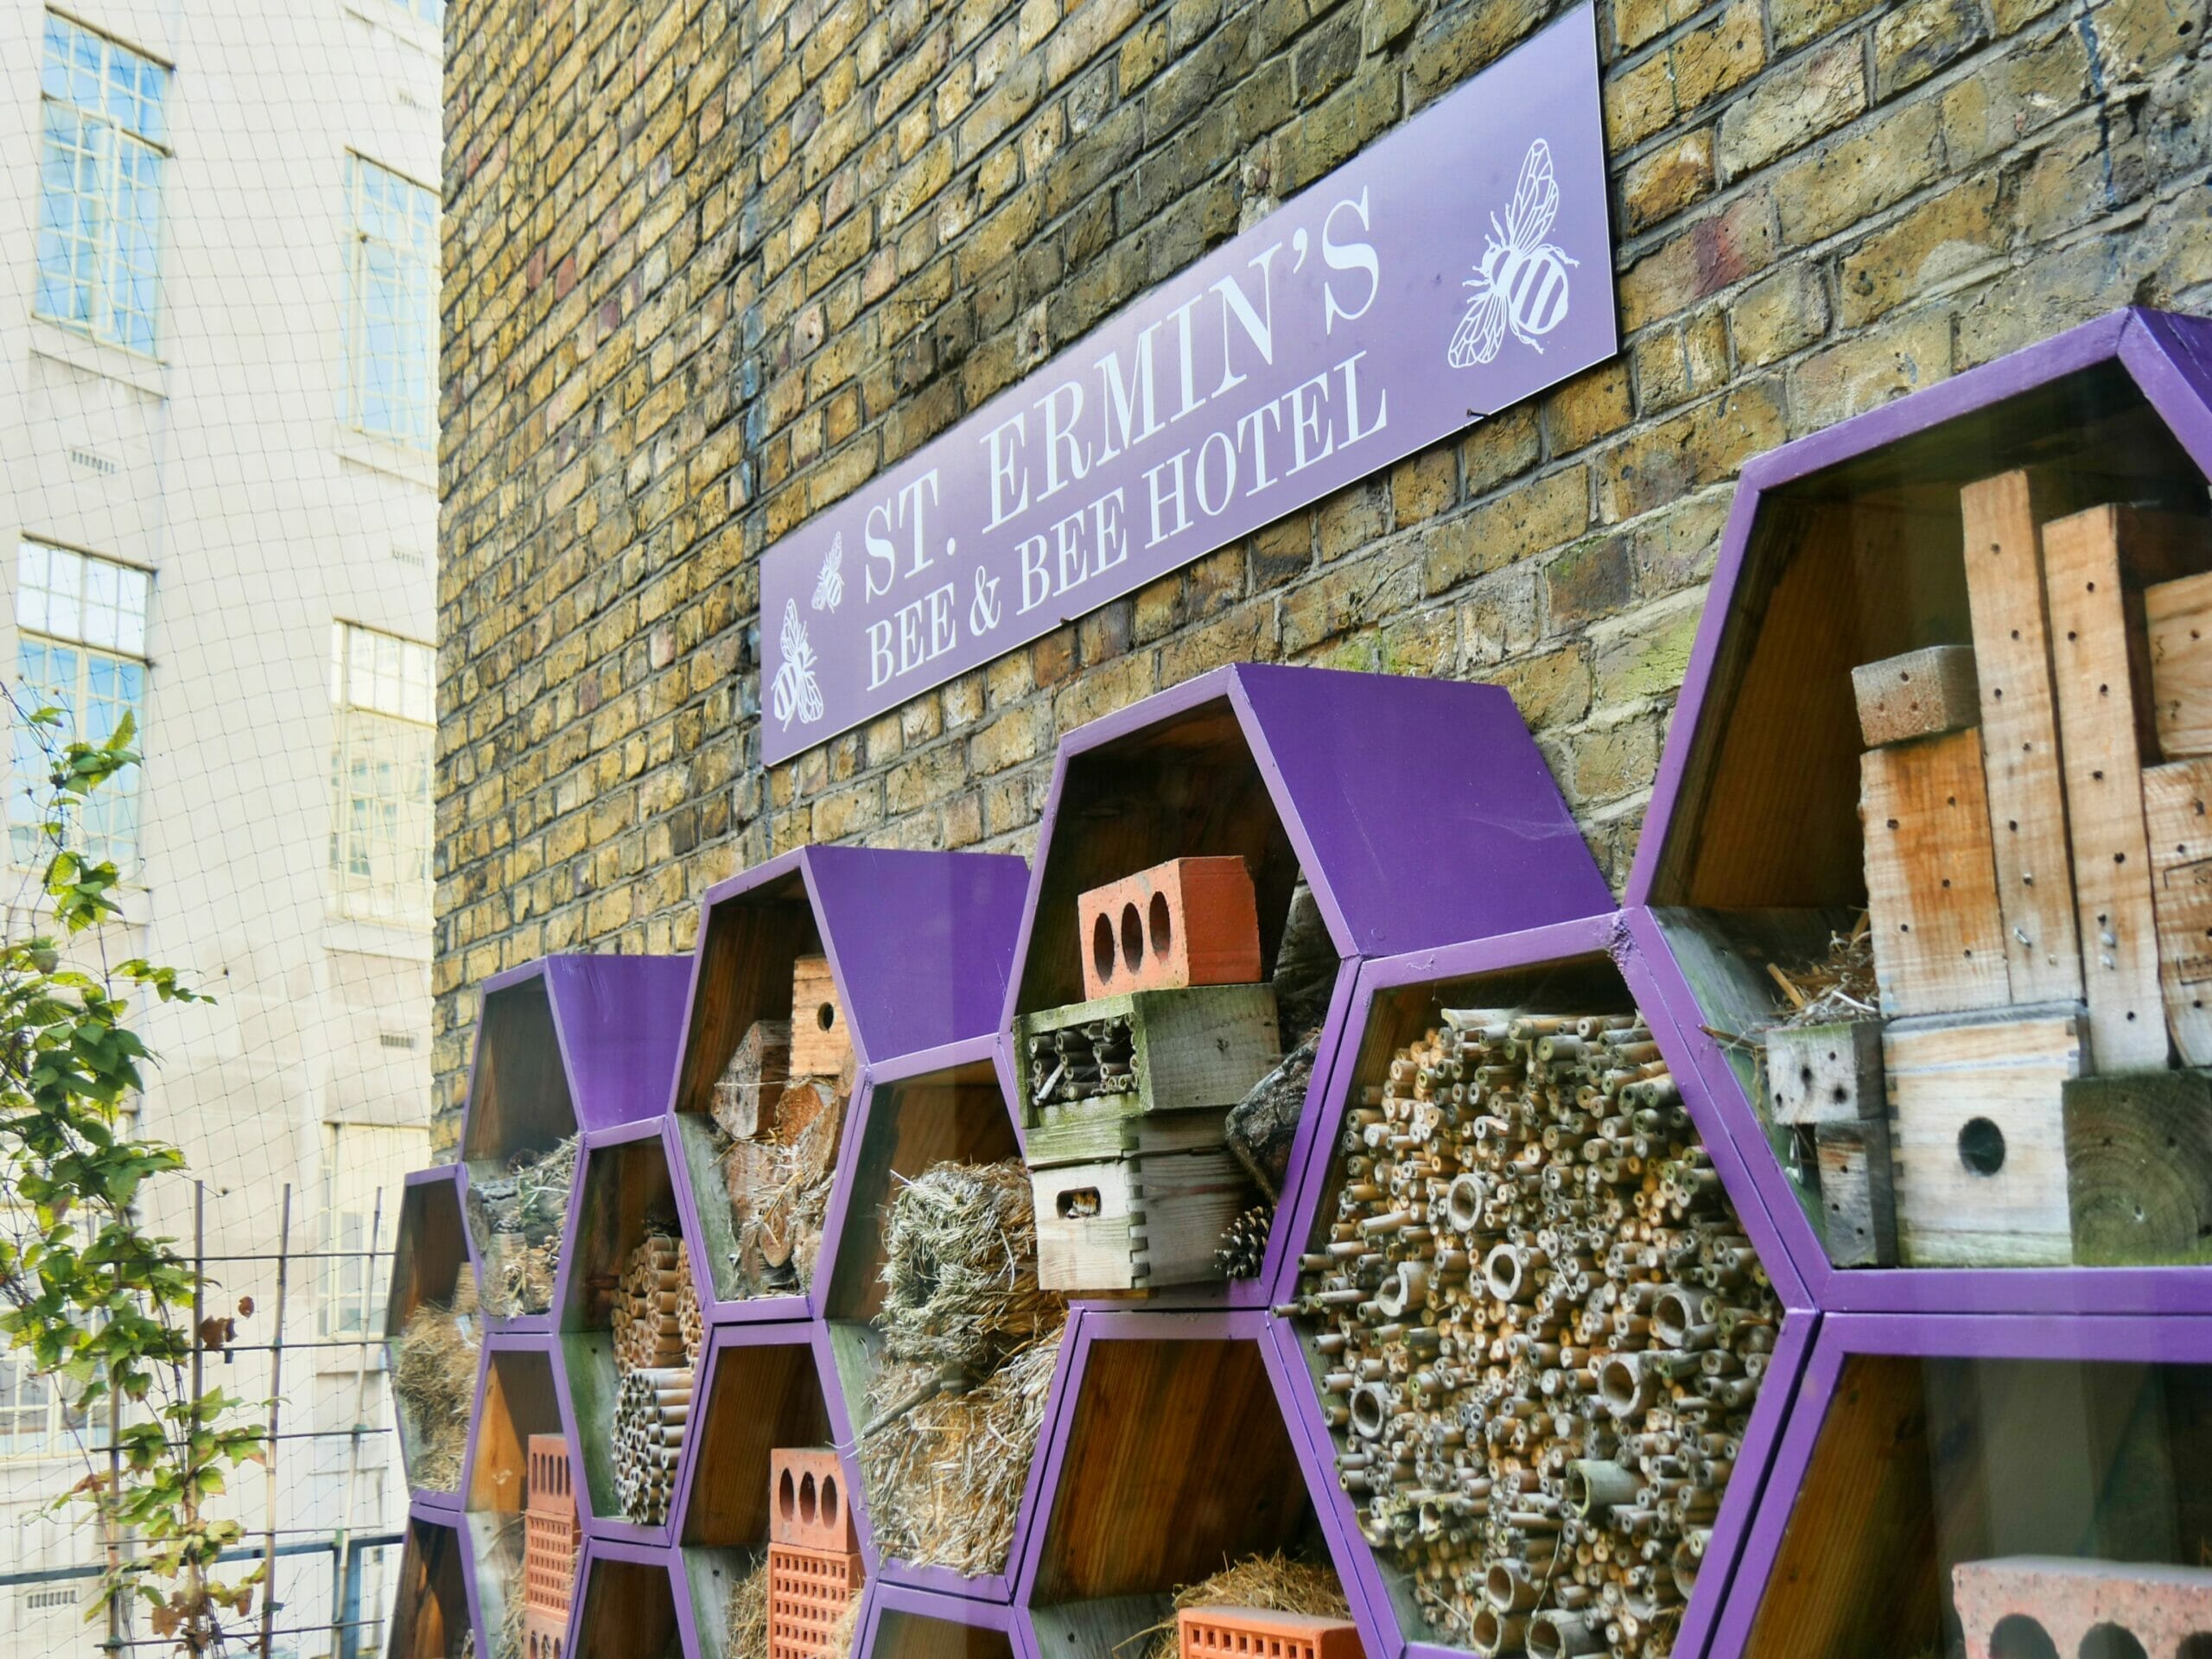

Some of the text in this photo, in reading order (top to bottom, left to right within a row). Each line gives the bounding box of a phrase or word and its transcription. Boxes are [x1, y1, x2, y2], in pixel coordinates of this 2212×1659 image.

[865, 185, 1380, 604] ST. ERMIN’S
[866, 350, 1387, 692] BEE & BEE HOTEL
